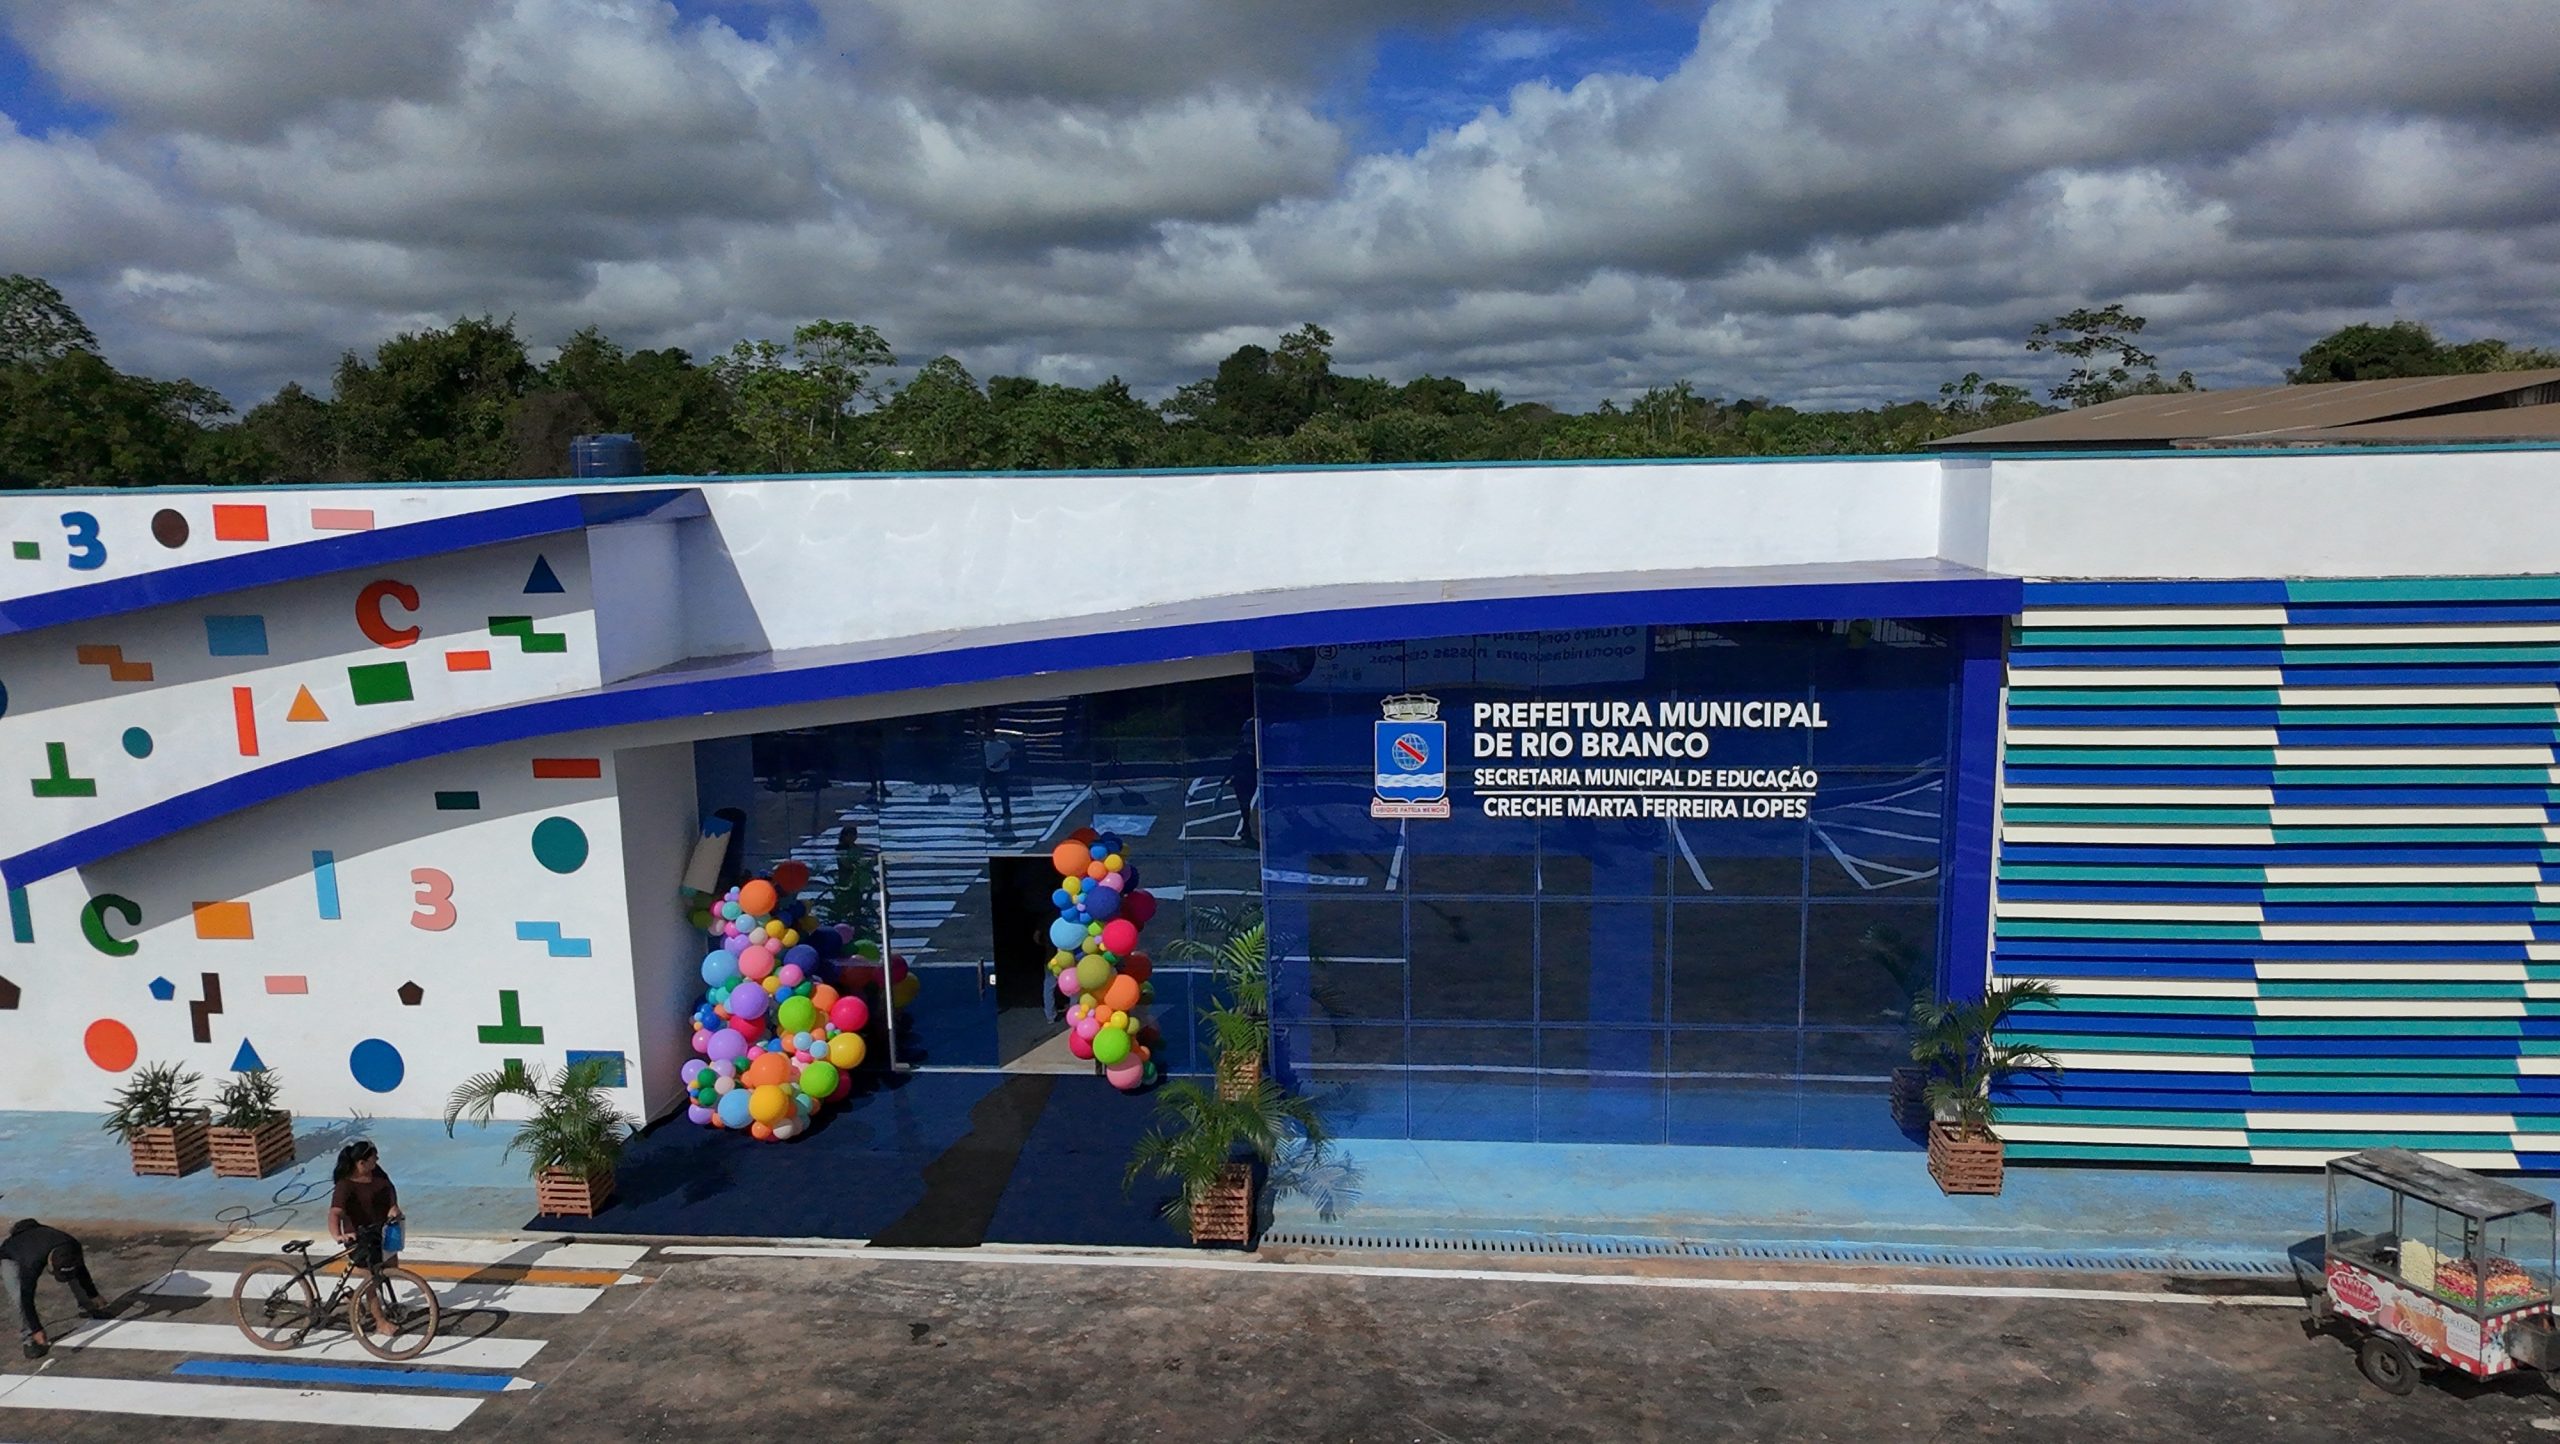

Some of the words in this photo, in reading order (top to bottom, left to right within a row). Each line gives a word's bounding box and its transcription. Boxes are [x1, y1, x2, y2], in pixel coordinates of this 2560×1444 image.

[60, 511, 107, 571] 3
[1474, 702, 1649, 729] PREFEITURA
[1659, 702, 1829, 729] MUNICIPAL
[1474, 733, 1514, 758] DE
[1521, 732, 1575, 758] RIO
[1582, 732, 1710, 759] BRANCO
[1474, 768, 1581, 787] SECRETARIA
[1585, 769, 1684, 788] MUNICIPAL
[1688, 770, 1713, 788] DE
[1717, 766, 1819, 792] EDUCAÇÃO
[1483, 798, 1564, 818] CRECHE
[1568, 798, 1640, 818] MARTA
[1643, 799, 1739, 819] FERREIRA
[1744, 799, 1808, 820] LOPES
[410, 868, 457, 931] 3
[2397, 1318, 2439, 1348] Crepe
